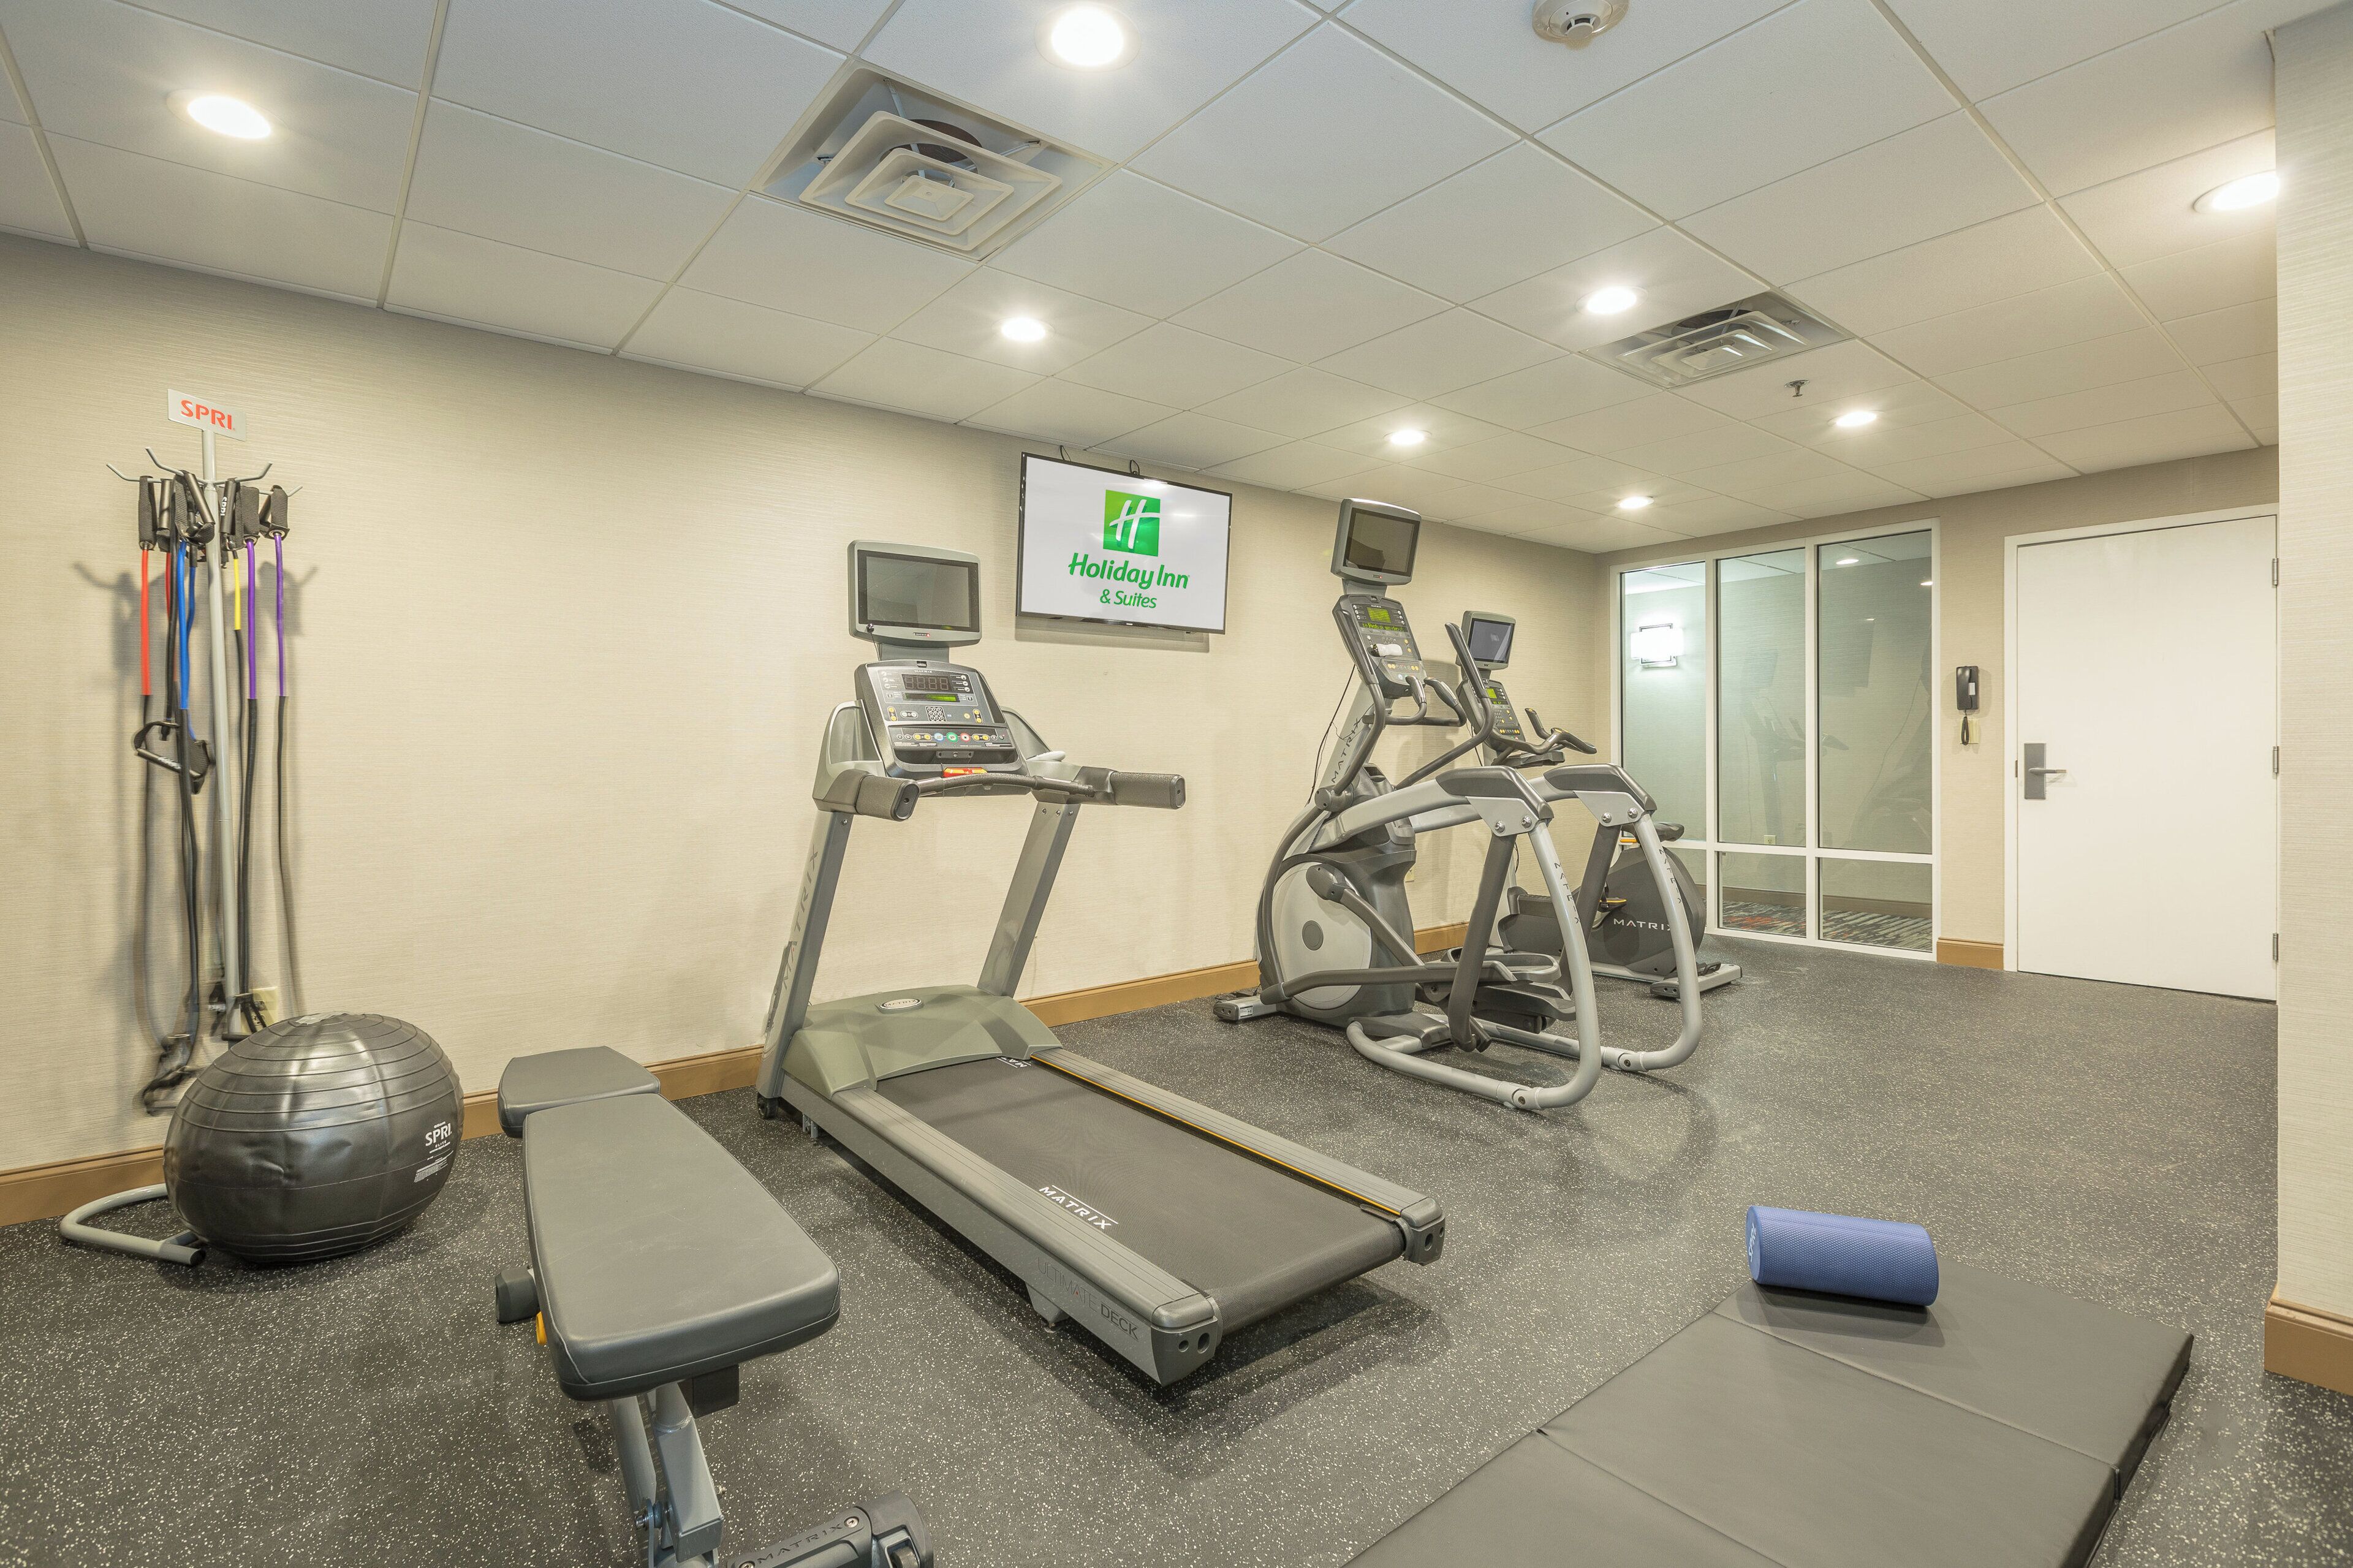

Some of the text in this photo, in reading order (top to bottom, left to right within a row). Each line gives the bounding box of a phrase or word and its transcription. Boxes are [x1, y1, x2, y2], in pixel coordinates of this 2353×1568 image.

[181, 400, 232, 430] SPRI
[1068, 553, 1189, 589] Holiday Inn
[1099, 589, 1157, 608] & Suites
[425, 1123, 450, 1146] SPRI
[1039, 1186, 1112, 1230] MATRIX
[1038, 1257, 1139, 1339] ULTIMATE DECK
[757, 1523, 843, 1564] MATRIX
